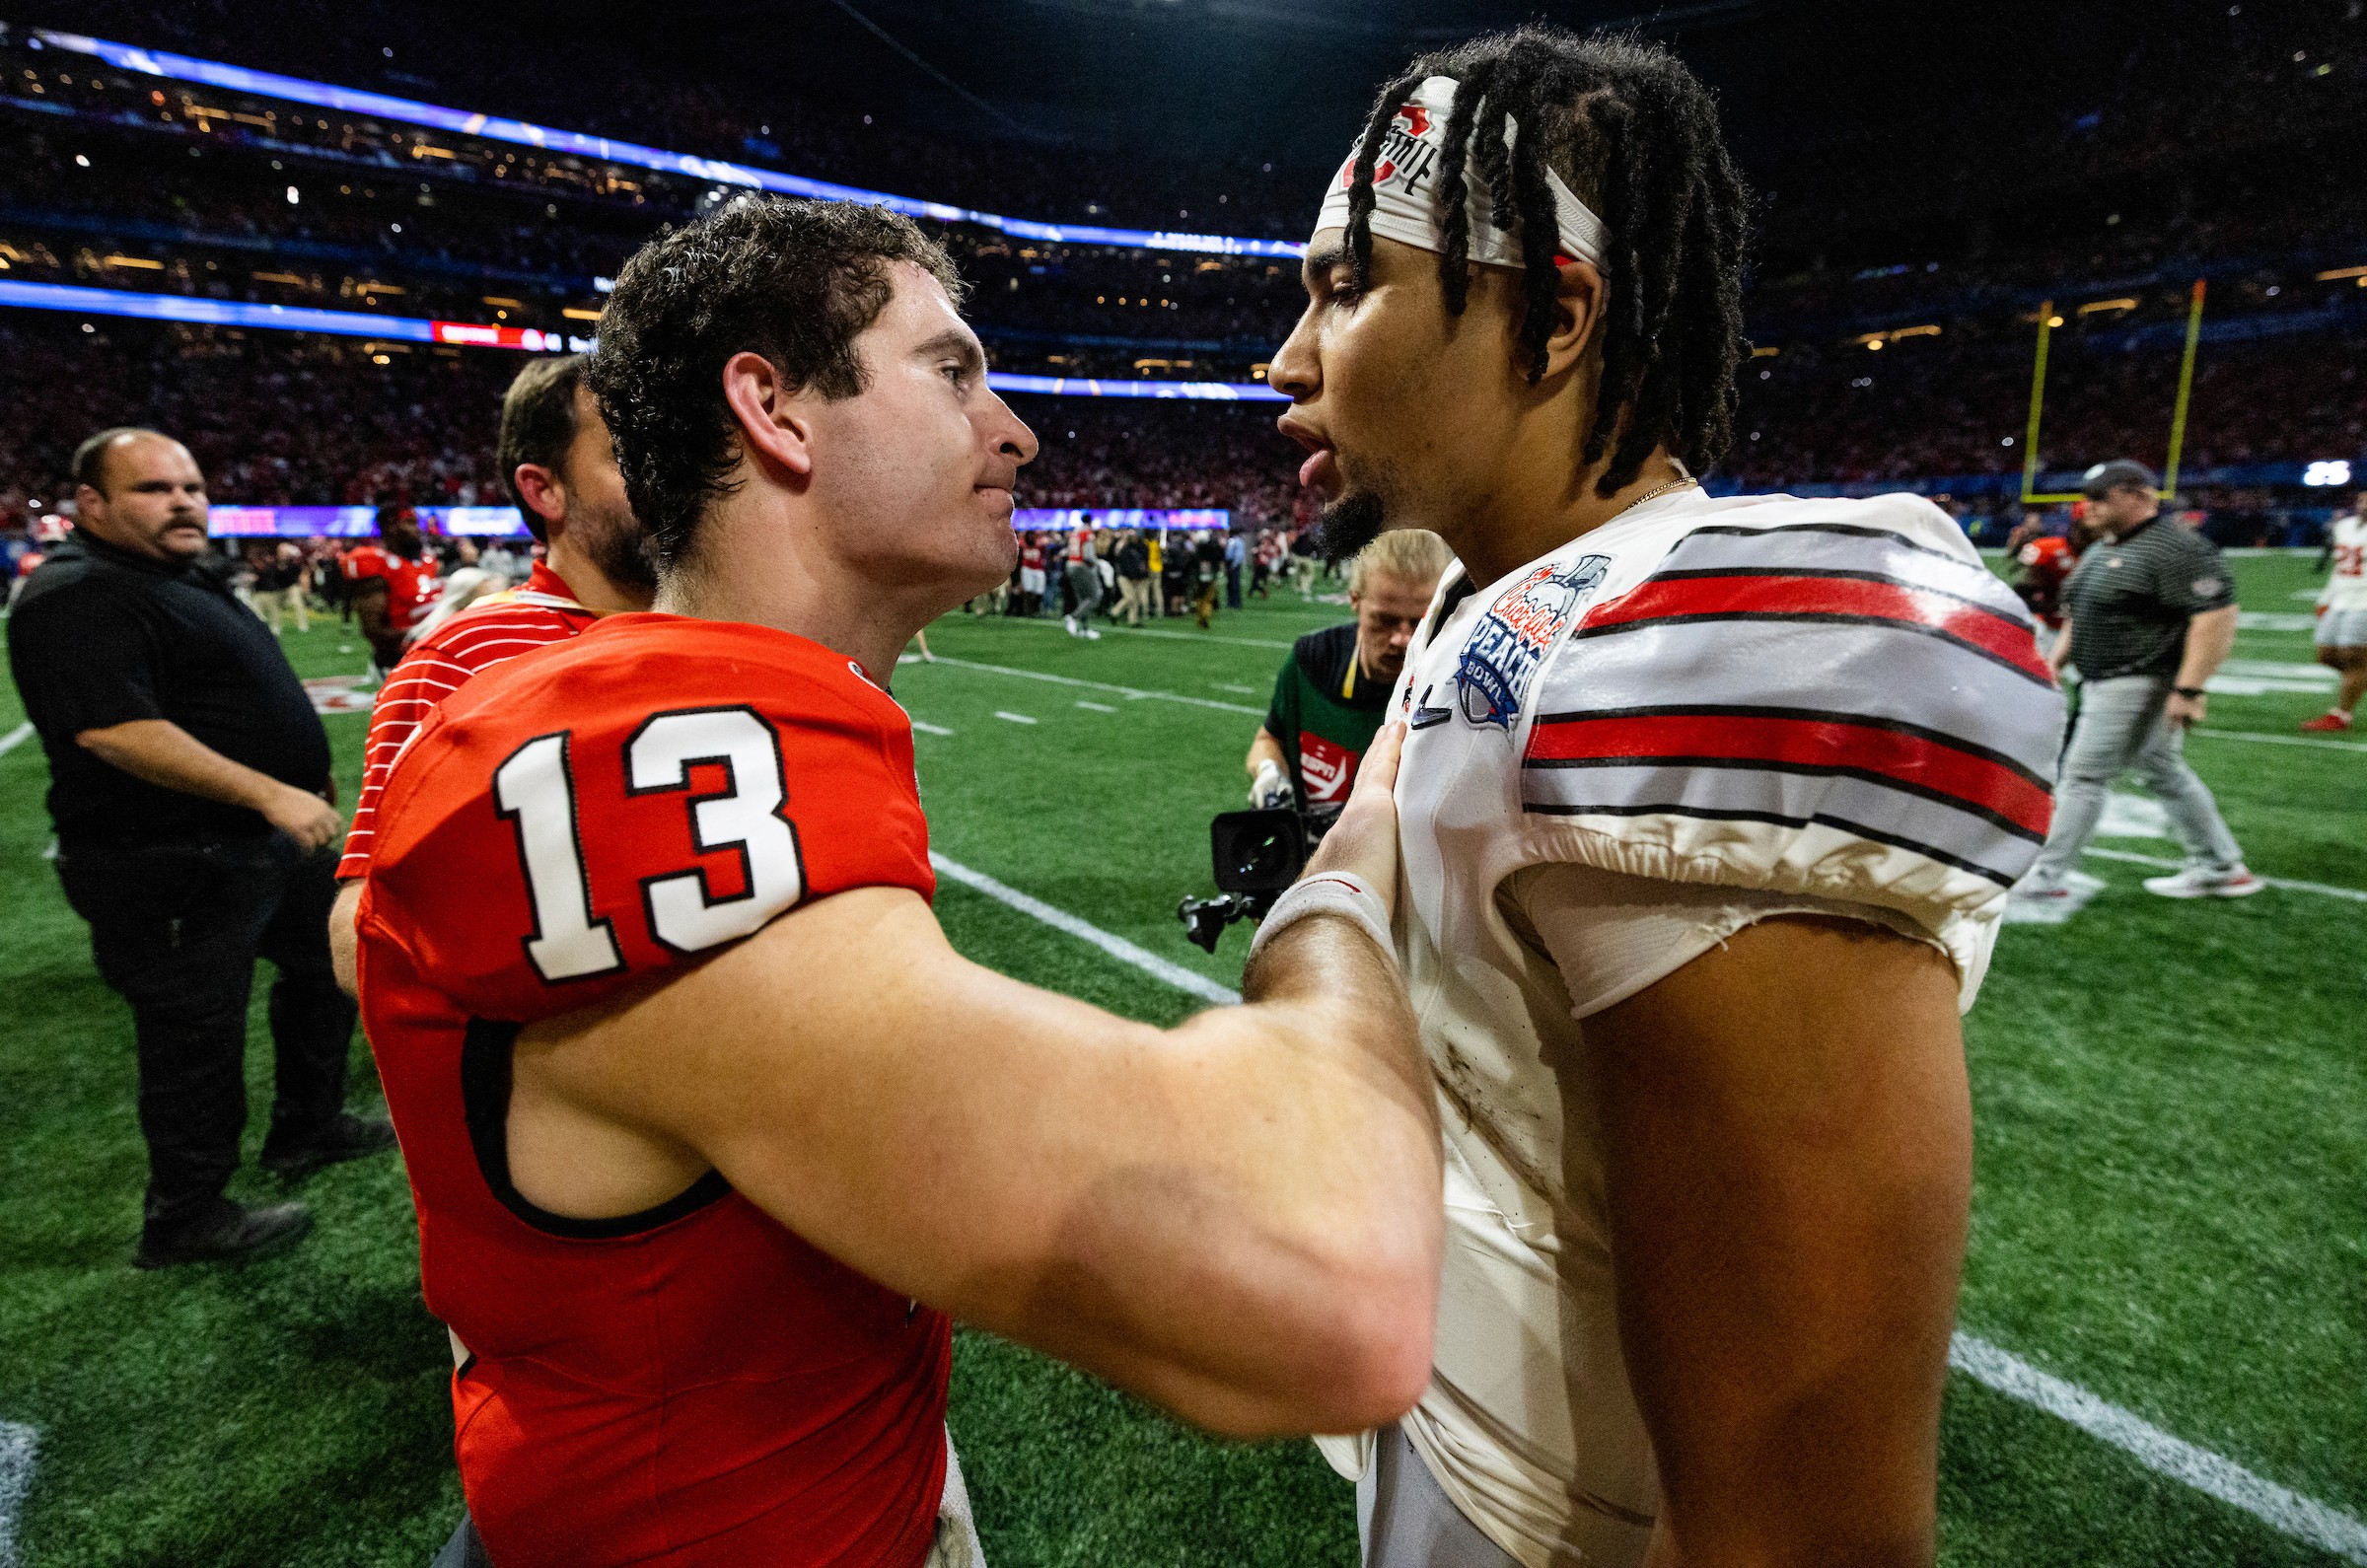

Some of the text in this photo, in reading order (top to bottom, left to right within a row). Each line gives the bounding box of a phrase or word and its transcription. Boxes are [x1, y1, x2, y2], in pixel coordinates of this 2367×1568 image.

[1463, 615, 1538, 702] PEACH
[1466, 660, 1501, 706] BOWL
[491, 704, 809, 986] 13
